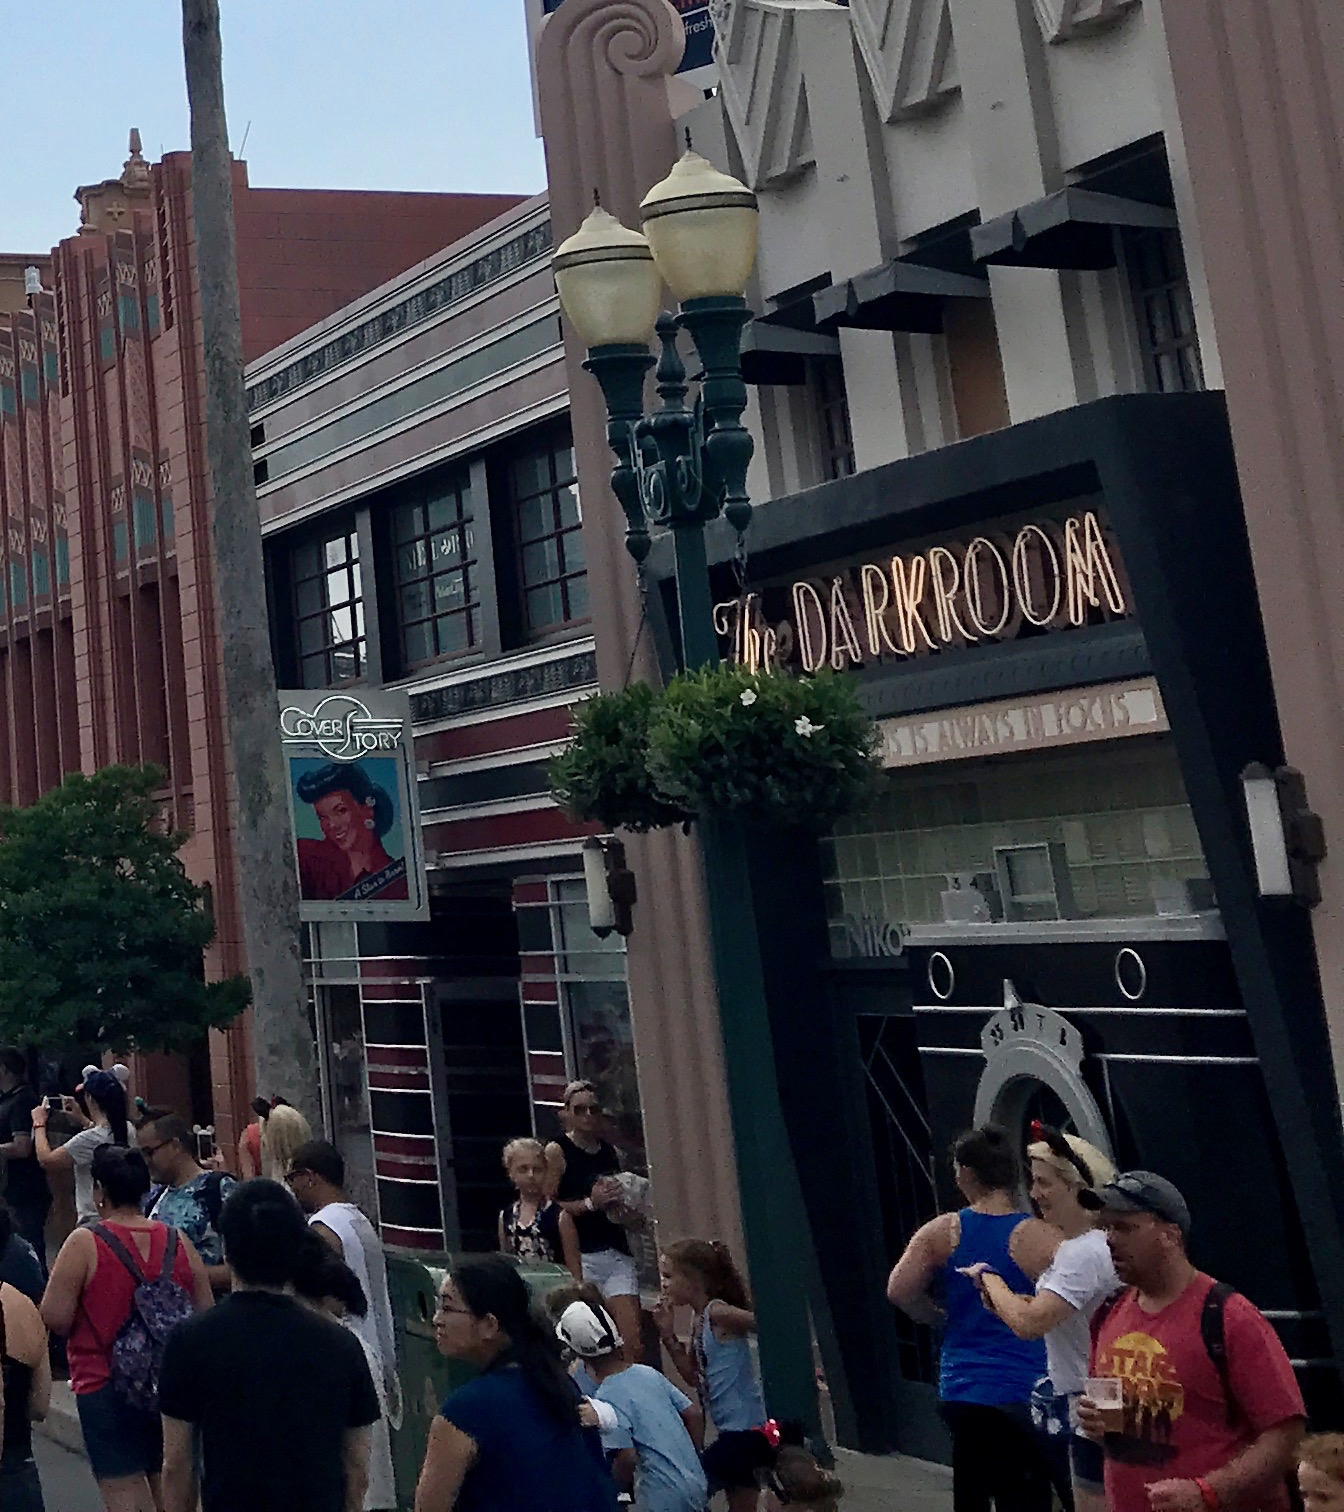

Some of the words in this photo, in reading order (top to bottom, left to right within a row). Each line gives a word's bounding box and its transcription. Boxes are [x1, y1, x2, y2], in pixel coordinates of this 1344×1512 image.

[713, 592, 778, 676] The
[793, 512, 1124, 672] DARKROOM
[281, 706, 343, 736] COVER
[337, 710, 402, 754] STORY
[938, 709, 1013, 752] ALWAYS
[1056, 693, 1129, 736] FOCUS
